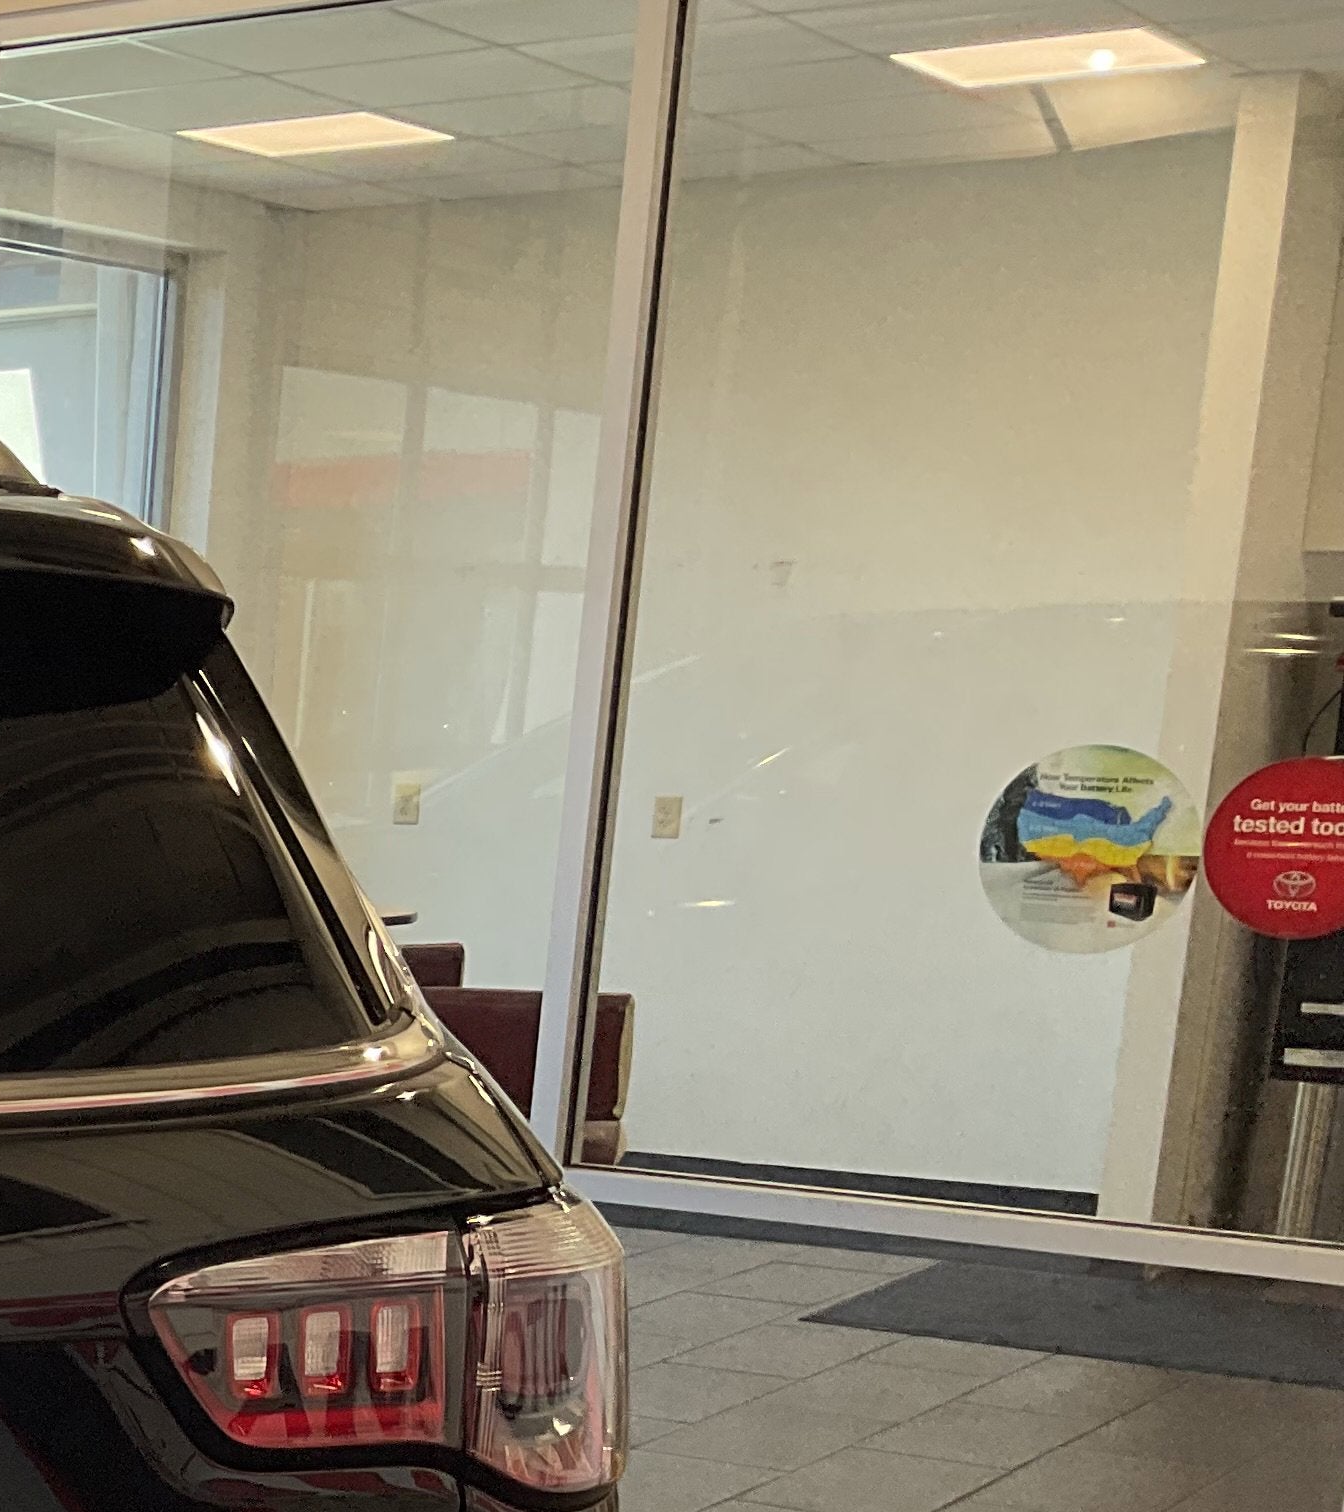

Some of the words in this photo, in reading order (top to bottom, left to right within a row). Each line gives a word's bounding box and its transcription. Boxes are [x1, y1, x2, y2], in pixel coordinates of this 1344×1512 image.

[1251, 798, 1275, 811] Get
[1278, 801, 1309, 813] your
[1233, 815, 1305, 835] tested
[1266, 899, 1317, 912] TOYOTA
